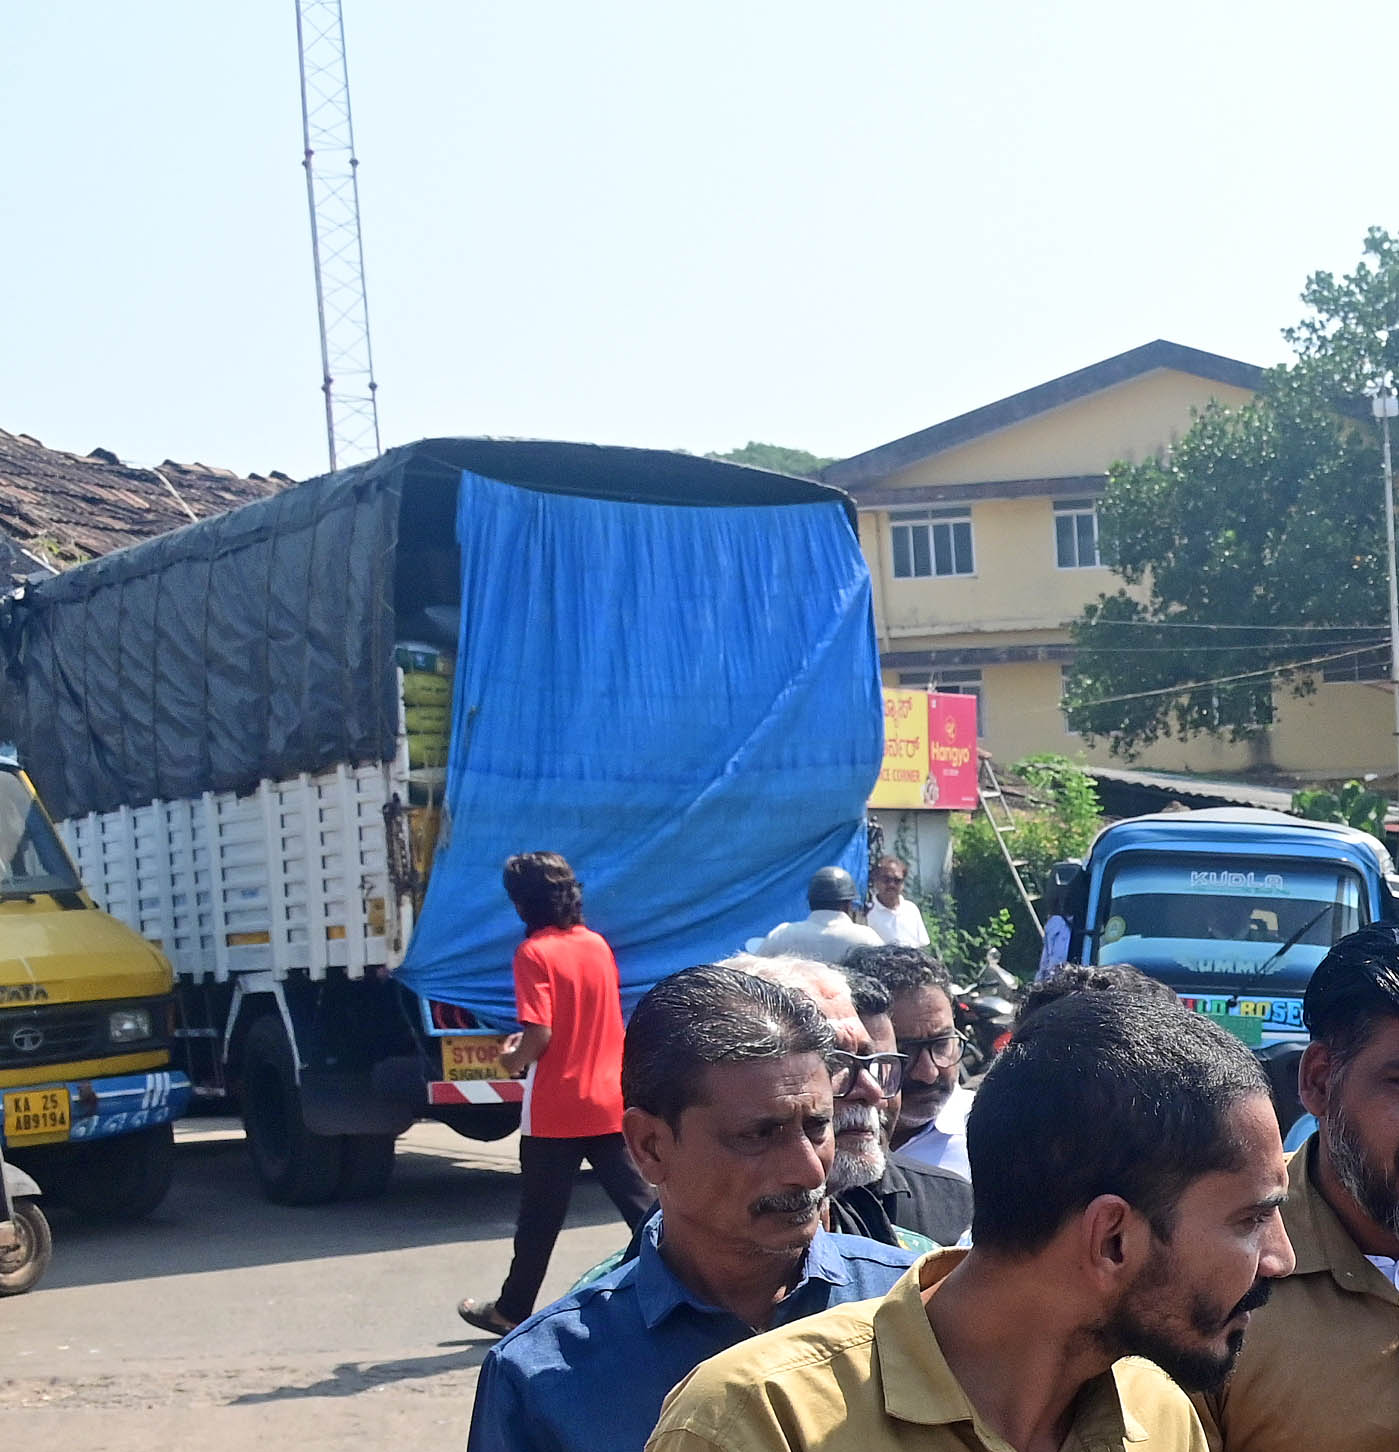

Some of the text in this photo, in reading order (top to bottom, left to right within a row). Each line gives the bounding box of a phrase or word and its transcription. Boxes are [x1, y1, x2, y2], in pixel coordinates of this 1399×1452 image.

[931, 741, 969, 767] Hangyo
[893, 769, 920, 782] CORNER
[1190, 871, 1284, 889] KUDLA
[1181, 998, 1304, 1028] ILD ROSE
[452, 1045, 498, 1065] STOP
[448, 1068, 498, 1080] SIGNAL
[14, 1095, 59, 1112] KA 25
[16, 1110, 66, 1131] AB9194
